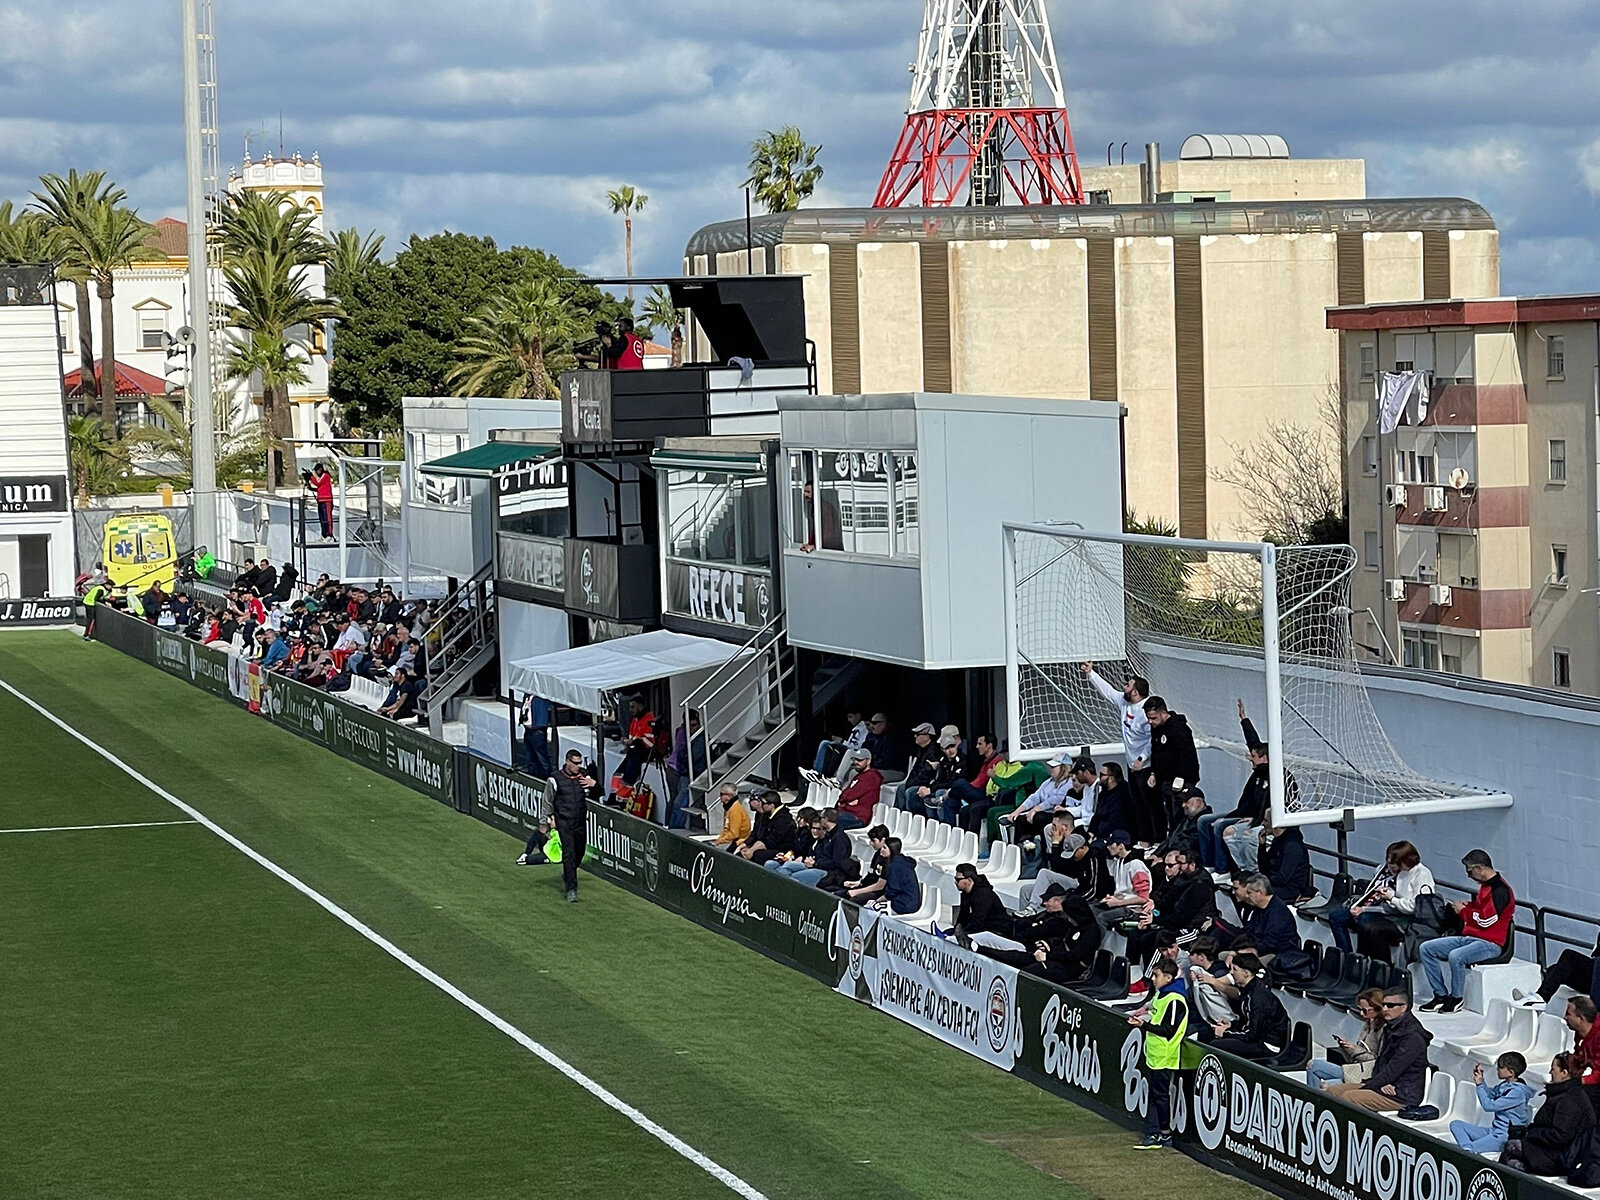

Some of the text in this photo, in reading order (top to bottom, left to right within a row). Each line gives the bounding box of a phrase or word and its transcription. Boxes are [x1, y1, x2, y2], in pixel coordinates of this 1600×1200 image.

[0, 484, 53, 503] um
[1, 602, 71, 620] J. Blanco
[488, 771, 498, 800] BS
[498, 775, 543, 819] ELECTRICIST
[585, 810, 631, 863] illenium
[668, 862, 689, 880] IMPRENTA
[691, 851, 764, 924] Olimpia
[765, 904, 792, 927] PAPELERÍA
[927, 947, 937, 973] ES
[952, 958, 982, 992] OPCIÓN
[923, 988, 936, 1021] AD
[936, 995, 963, 1036] CEUTA
[964, 1005, 980, 1046] FC!
[1061, 1003, 1082, 1031] Café
[1230, 1071, 1463, 1200] DARYSO MOTOR
[1225, 1134, 1262, 1164] Recambios
[1262, 1153, 1268, 1170] y
[1268, 1153, 1305, 1183] Accesorios
[1305, 1170, 1316, 1188] de
